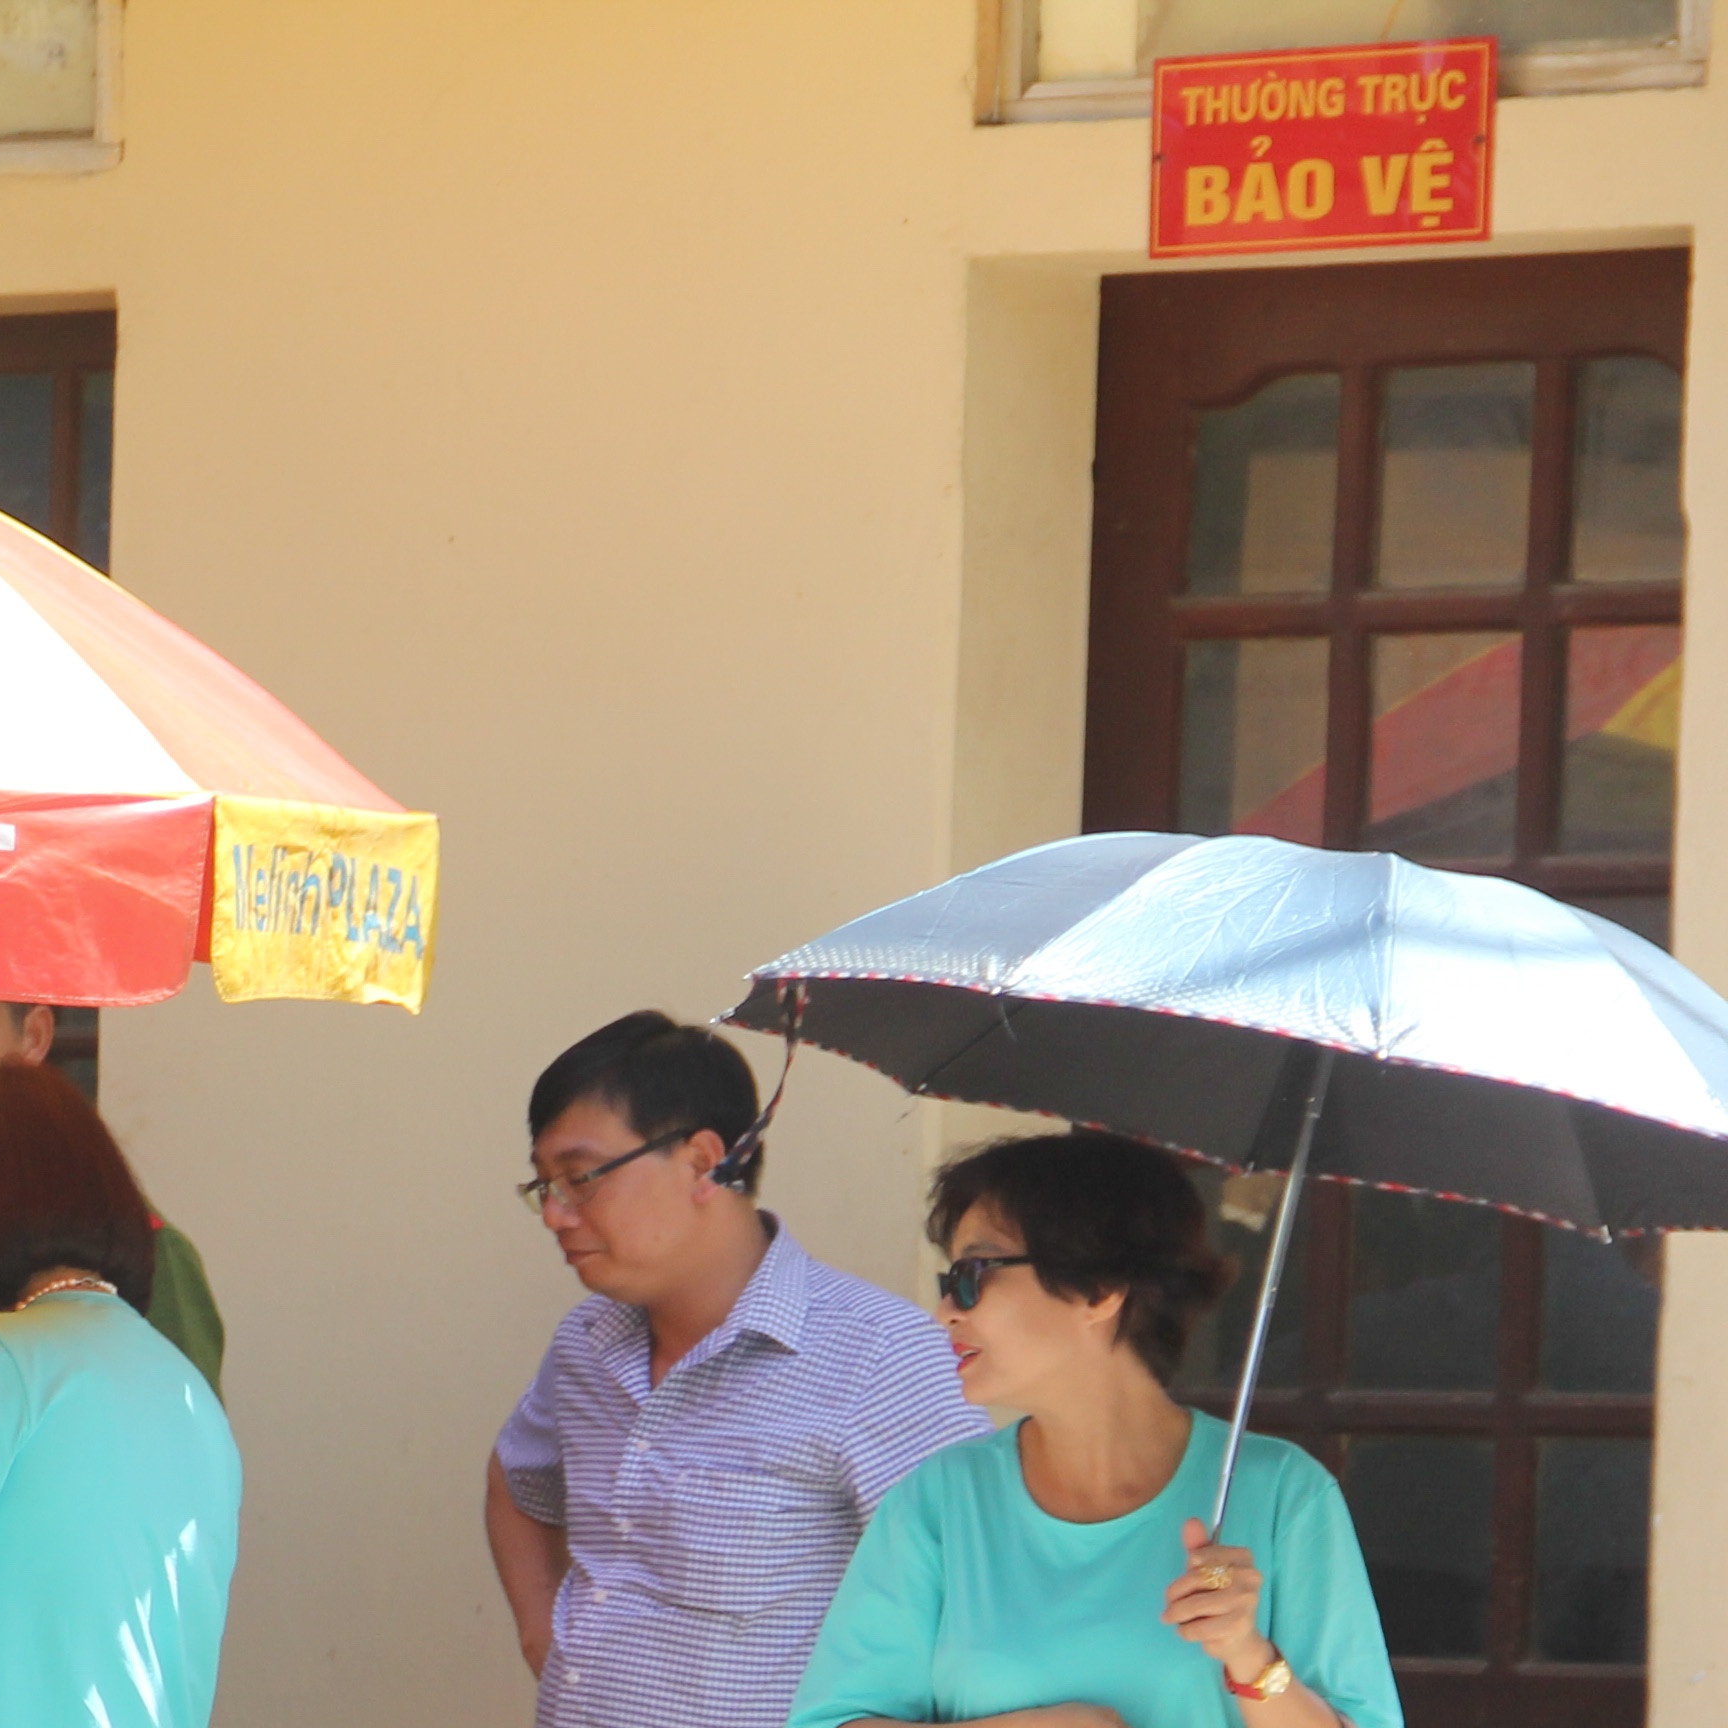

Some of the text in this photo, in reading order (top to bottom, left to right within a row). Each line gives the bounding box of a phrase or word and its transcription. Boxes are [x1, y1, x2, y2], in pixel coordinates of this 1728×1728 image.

[1179, 68, 1467, 126] THƯỜNG TRỰC
[1184, 134, 1455, 228] BẢO VỆ
